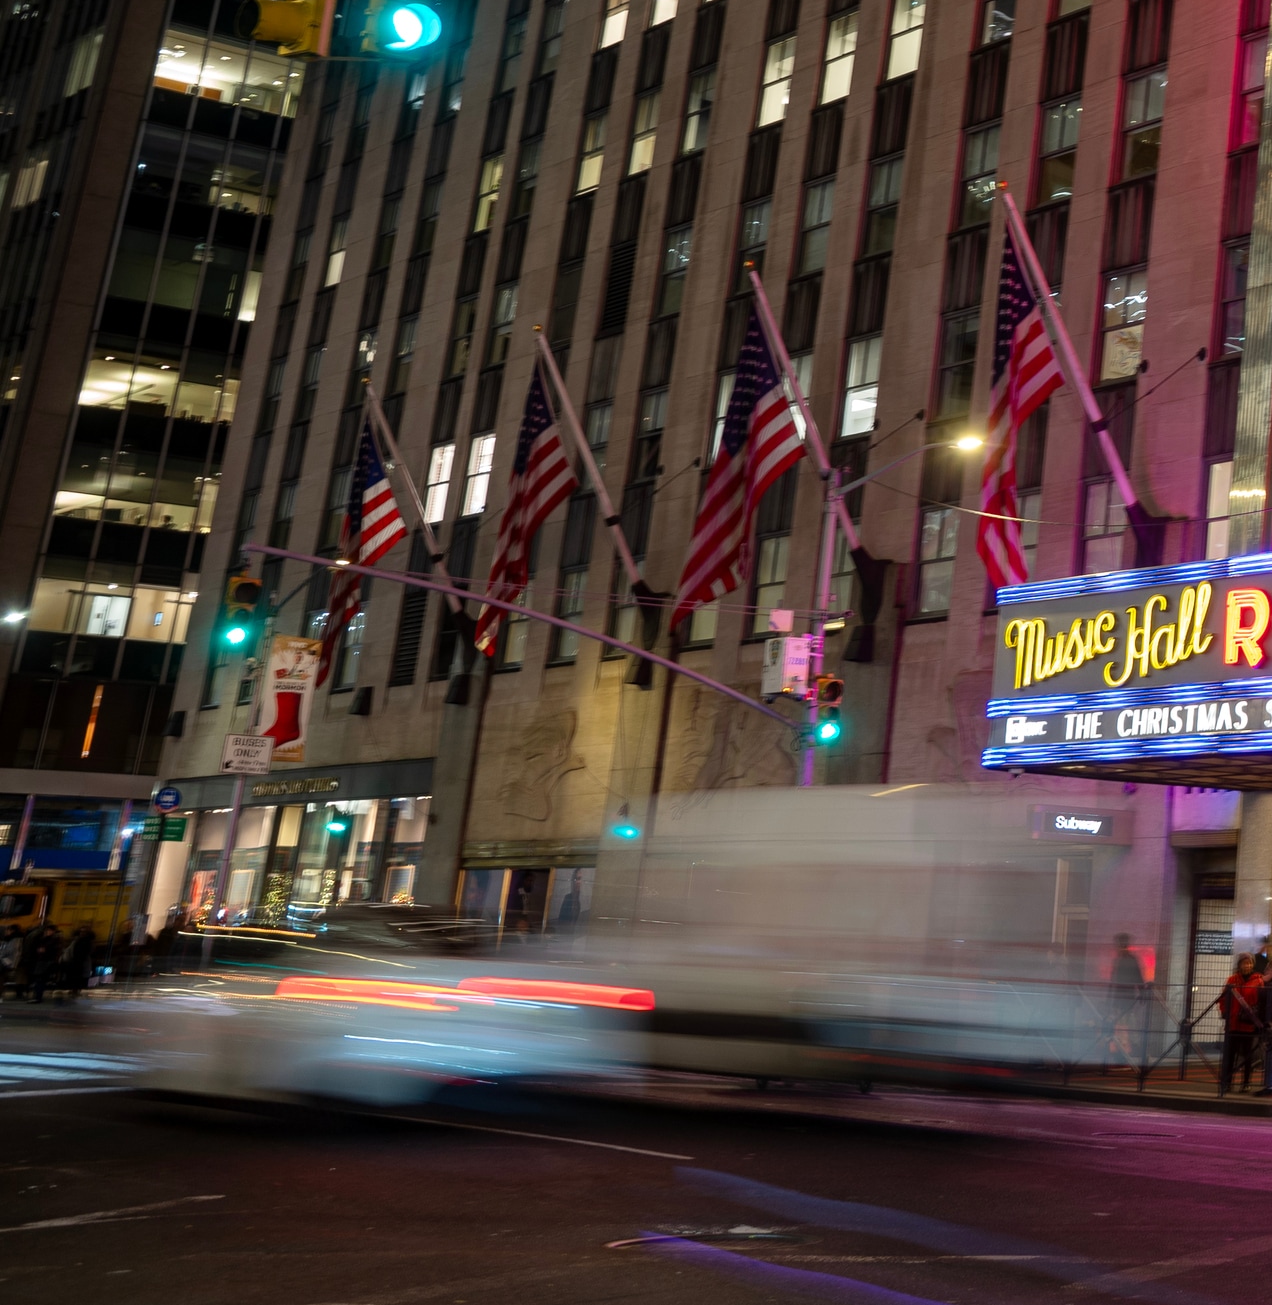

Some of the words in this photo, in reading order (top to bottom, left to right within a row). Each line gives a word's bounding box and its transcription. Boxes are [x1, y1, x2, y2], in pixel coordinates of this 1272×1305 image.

[1005, 608, 1117, 689] Music
[1104, 580, 1214, 687] Hall
[1064, 711, 1103, 741] THE
[1116, 698, 1249, 738] CHRISTMAS
[1055, 815, 1102, 834] Subway
